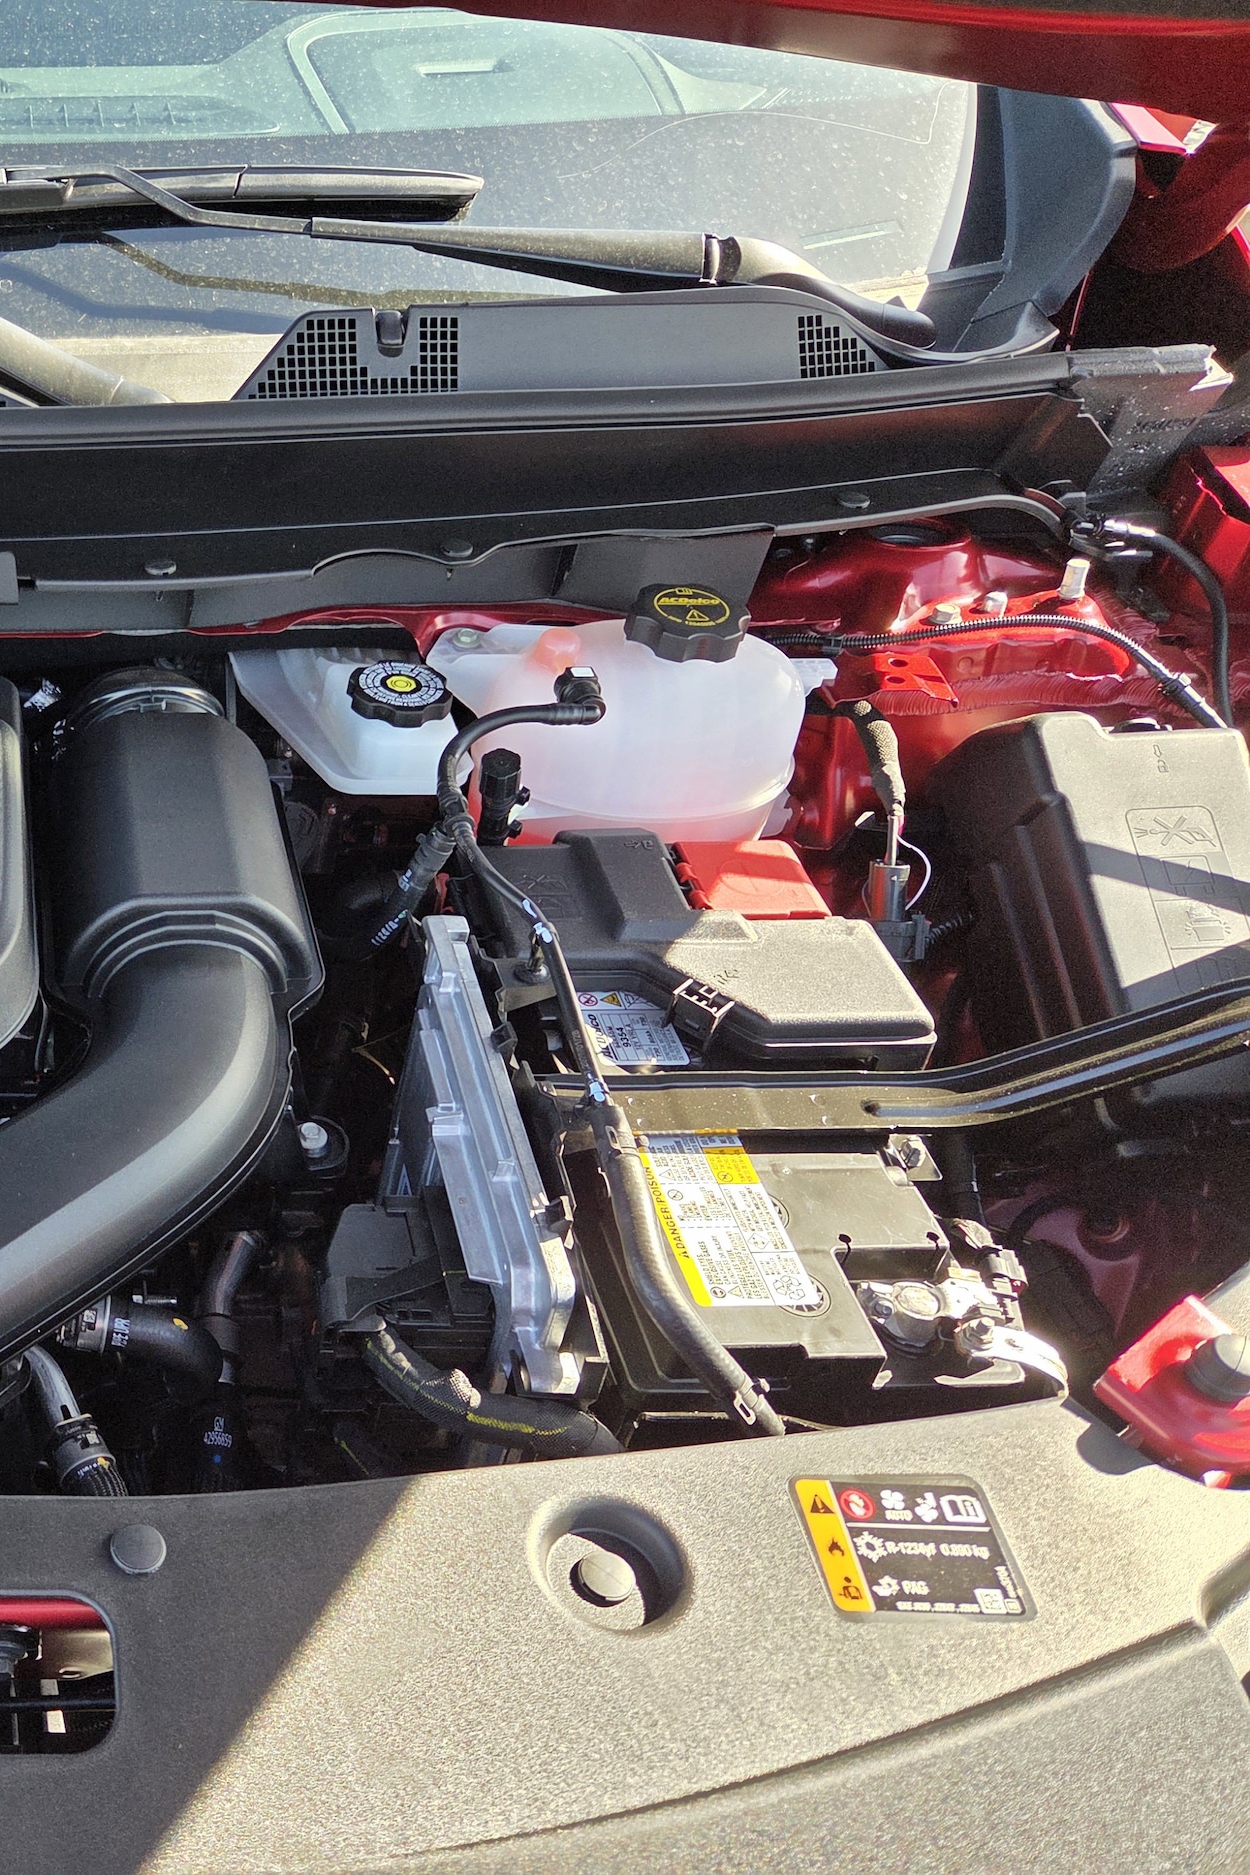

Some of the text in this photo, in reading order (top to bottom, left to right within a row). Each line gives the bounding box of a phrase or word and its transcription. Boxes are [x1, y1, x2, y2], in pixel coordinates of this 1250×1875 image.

[657, 597, 720, 605] ACDelco
[886, 1541, 937, 1558] R-1234yf
[973, 1545, 991, 1560] kg
[901, 1580, 930, 1595] PAG
